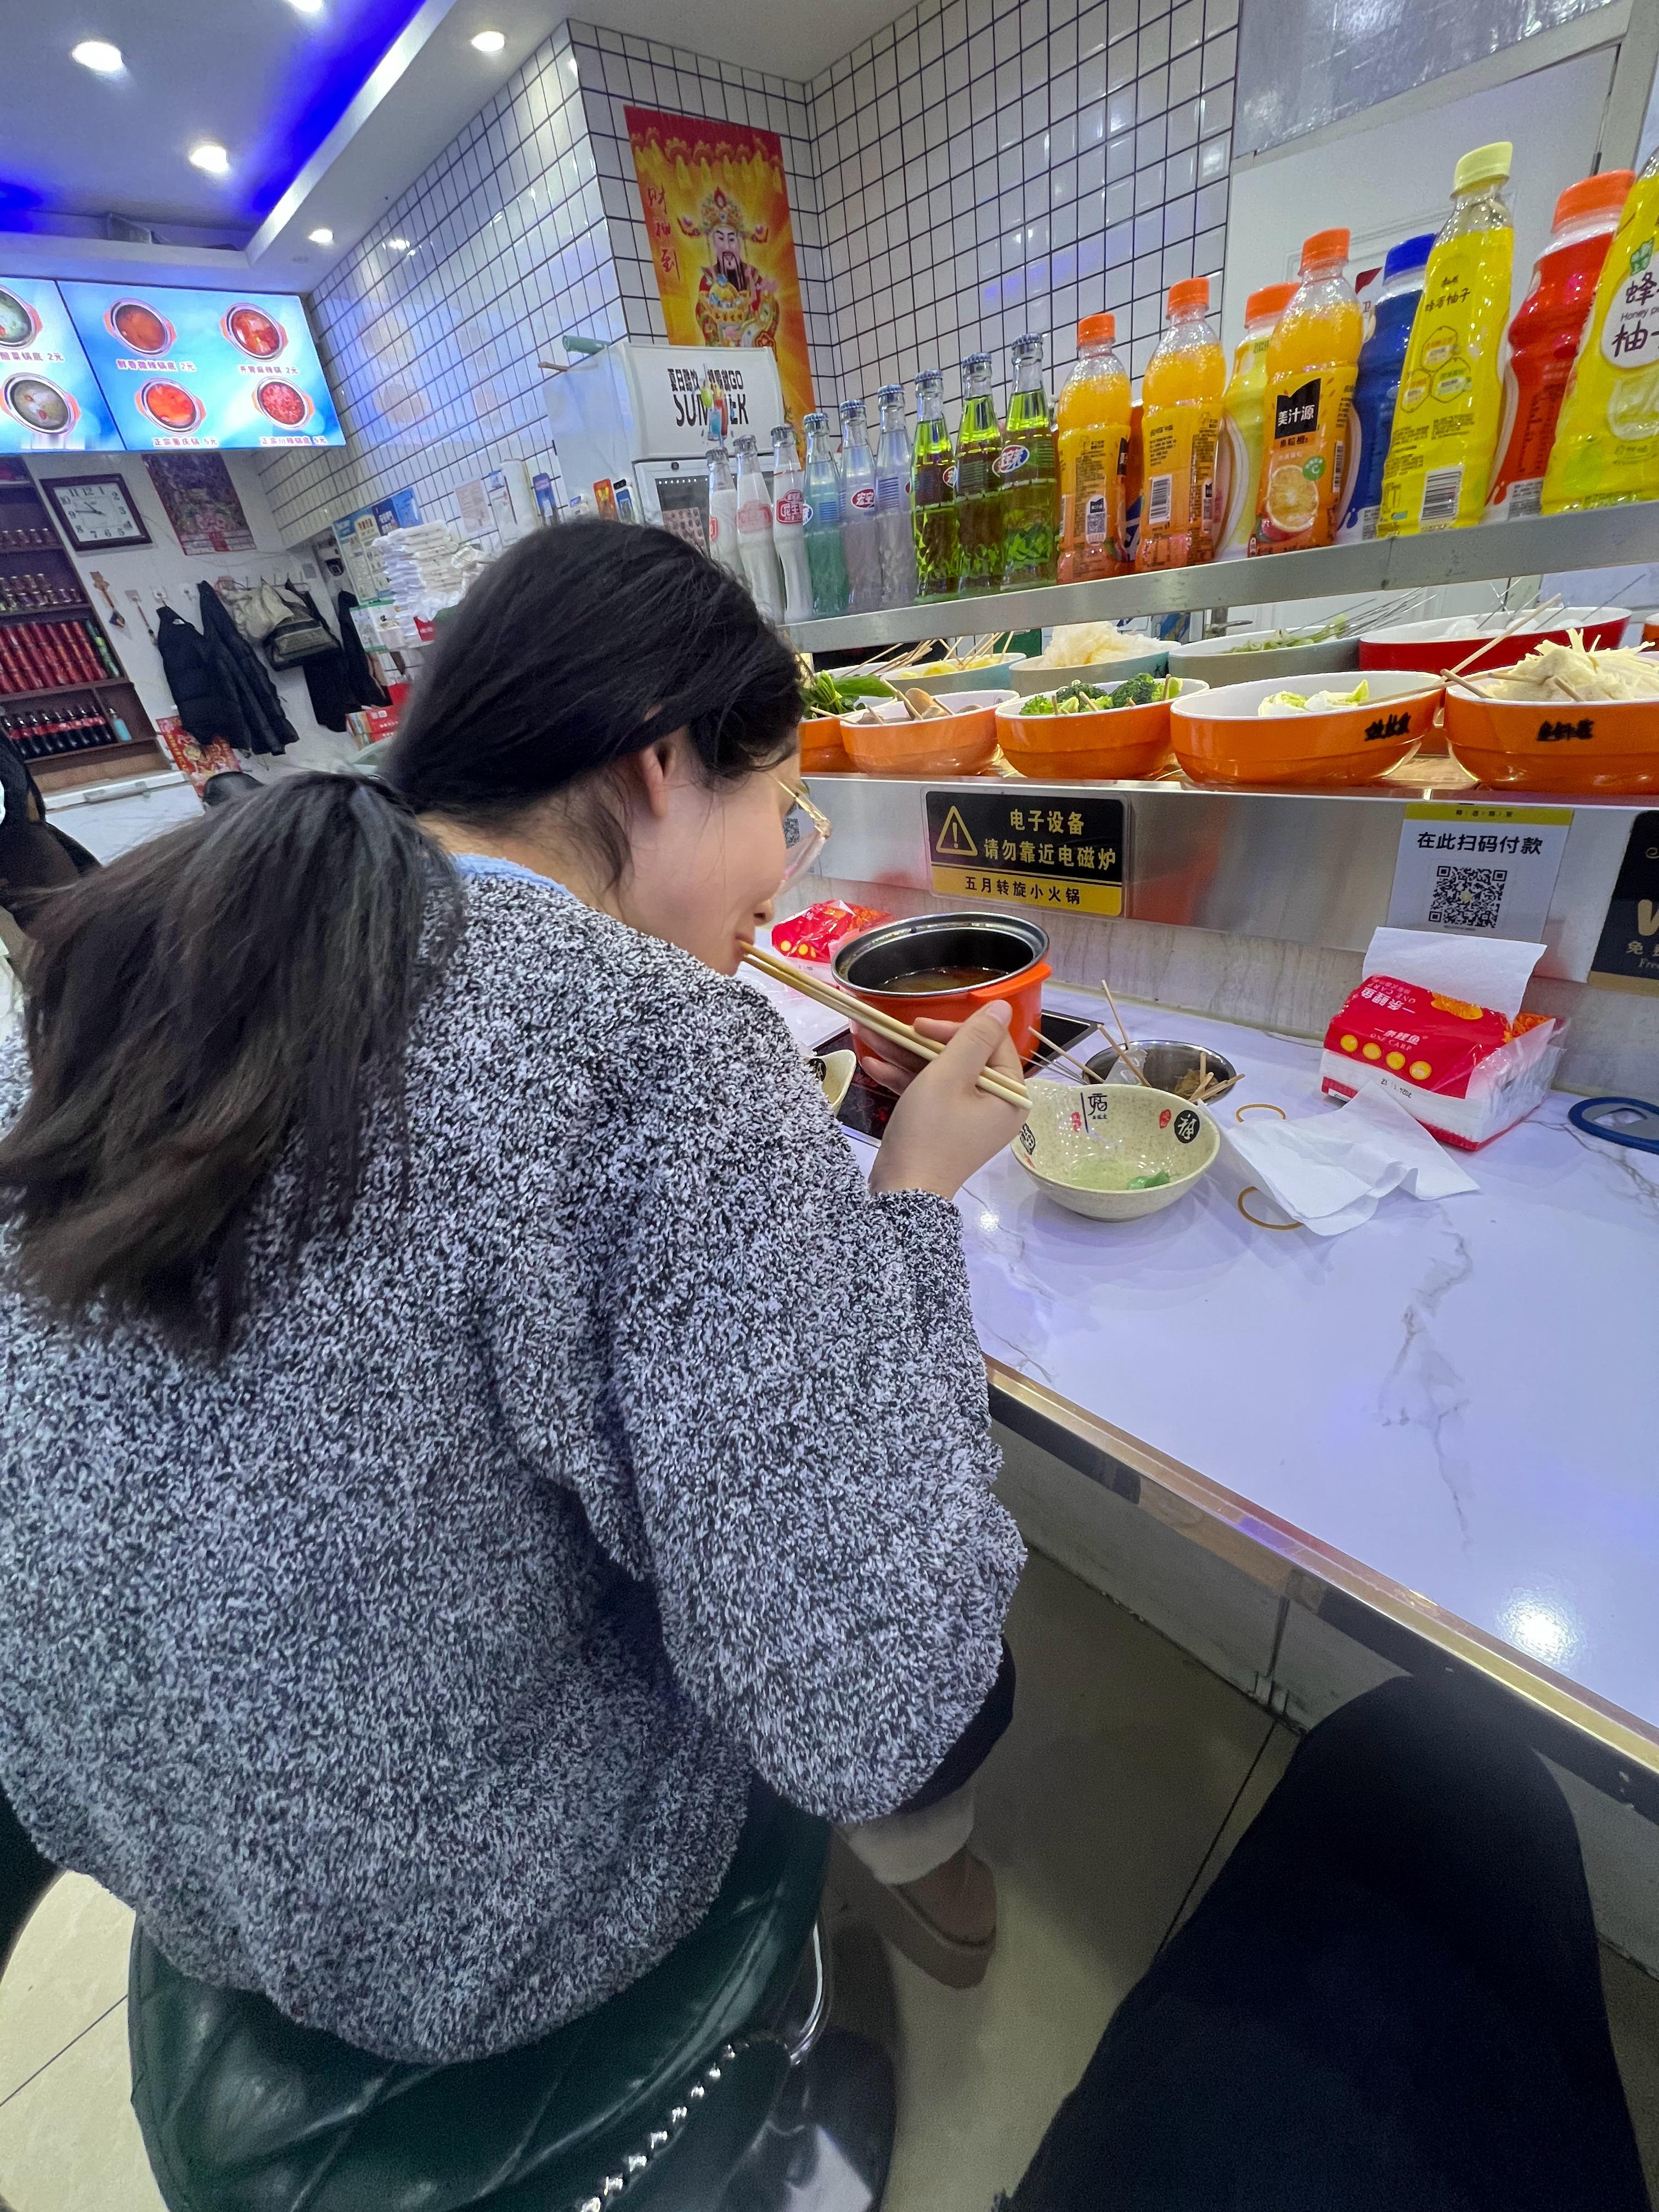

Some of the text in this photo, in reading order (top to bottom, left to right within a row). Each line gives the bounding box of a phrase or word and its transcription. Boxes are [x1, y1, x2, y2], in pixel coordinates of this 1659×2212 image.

[1626, 272, 1659, 306] 蜂
[1621, 308, 1649, 321] Honey
[47, 353, 64, 362] 2元
[180, 362, 195, 370] 2元
[1277, 404, 1315, 426] 美汁源
[82, 487, 93, 495] 12
[112, 492, 120, 500] 2
[69, 506, 126, 519] 9 3
[76, 525, 84, 533] 8
[1010, 808, 1084, 836] 电子设备
[1417, 831, 1543, 855] 在此扫码付款
[984, 838, 1116, 871] 请勿靠近电磁炉
[965, 876, 1081, 905] 五月转旋小火锅
[1361, 987, 1416, 1014] 一条鲤鱼
[1370, 1033, 1413, 1051] ONE CARP
[1373, 1028, 1420, 1045] 一条鲤鱼
